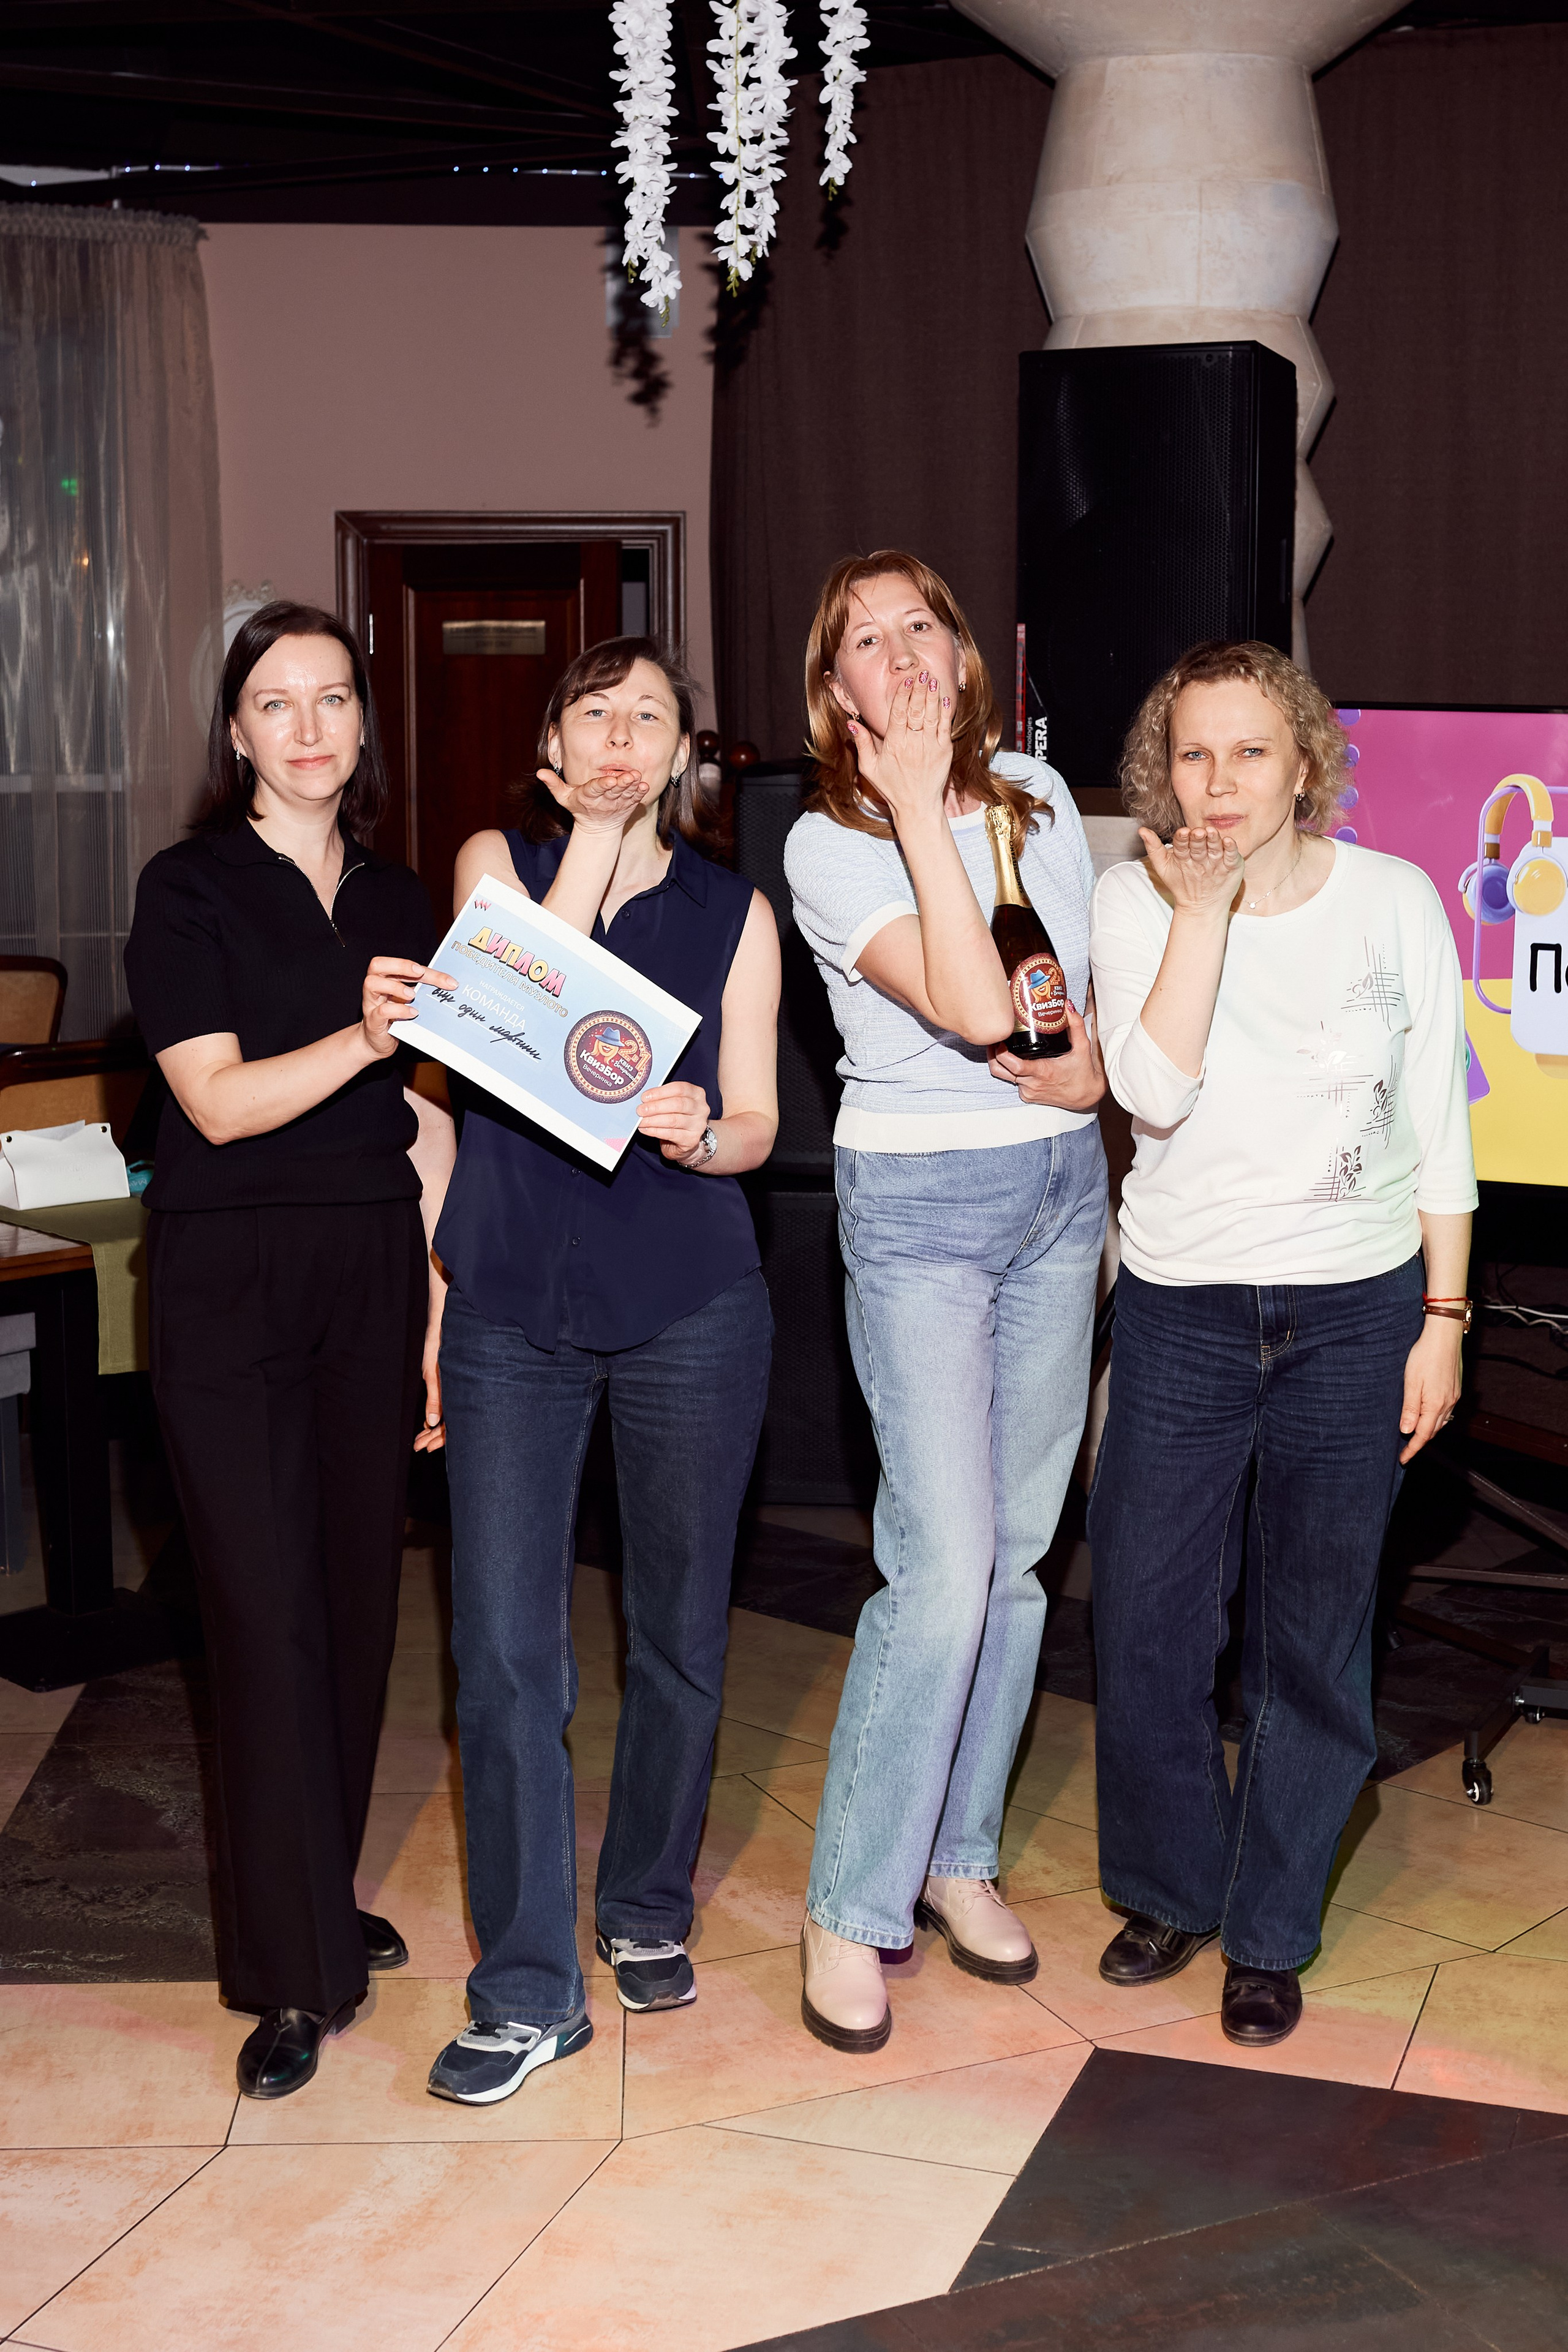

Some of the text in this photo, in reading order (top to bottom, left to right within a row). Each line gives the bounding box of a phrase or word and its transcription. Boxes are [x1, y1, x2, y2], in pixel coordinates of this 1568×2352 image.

[1035, 717, 1047, 761] PERA
[451, 941, 568, 1018] ПОБЕДИТЕЛЯ МУЗЛОТО
[468, 926, 567, 998] ДИПЛОМ
[1529, 943, 1568, 993] П
[458, 1004, 486, 1022] один
[462, 984, 526, 1031] КОМАНДА
[479, 981, 525, 1011] НАГРАЖДАЕТСЯ
[1031, 998, 1065, 1011] КвизБор
[579, 1049, 625, 1085] КвизБор
[582, 1063, 612, 1087] Вечеринка
